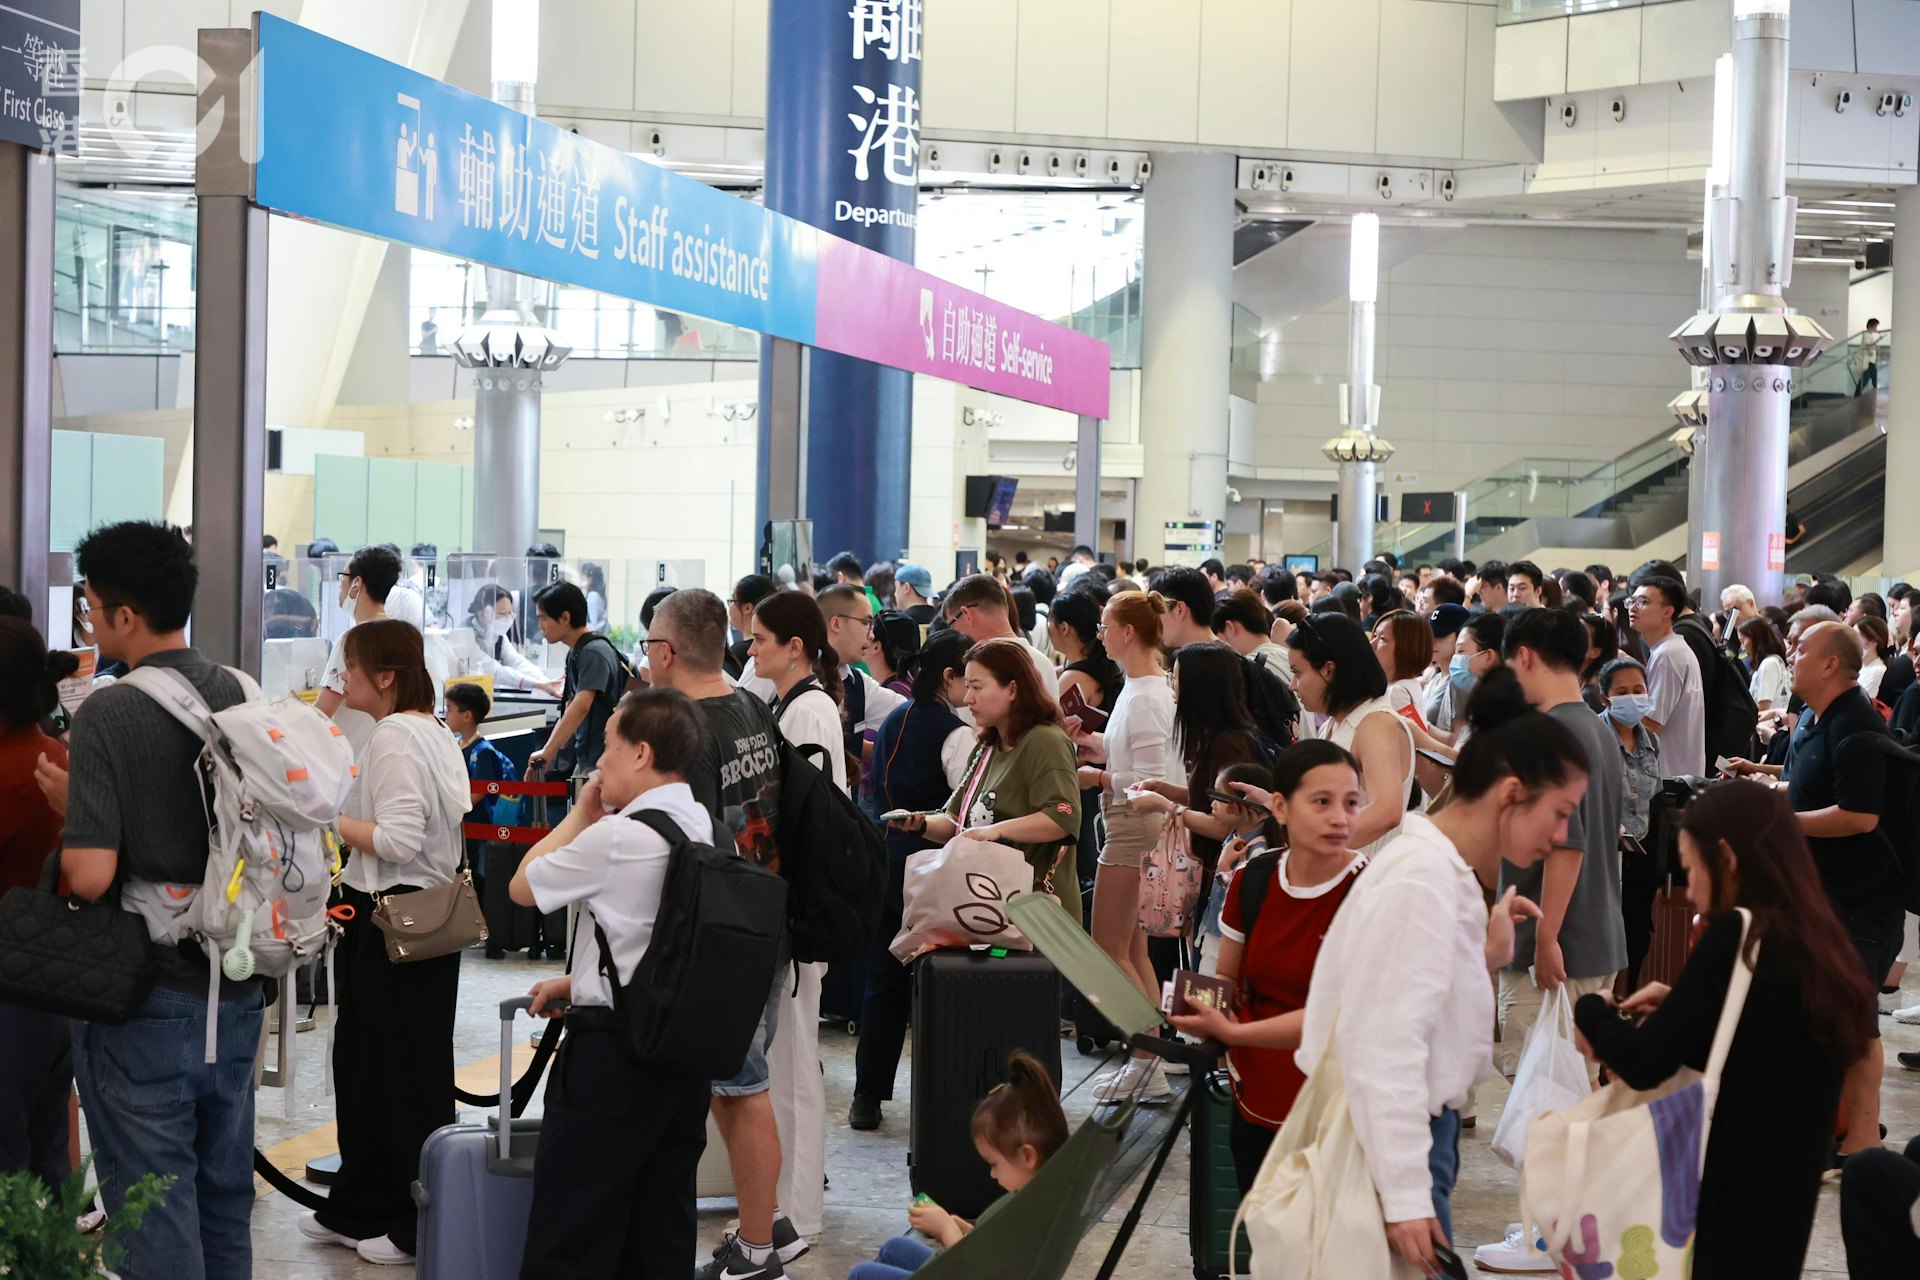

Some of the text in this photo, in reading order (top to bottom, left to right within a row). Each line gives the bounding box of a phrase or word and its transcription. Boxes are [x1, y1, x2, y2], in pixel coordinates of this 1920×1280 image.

[1, 32, 65, 89] 一等座
[3, 88, 65, 131] First Class
[458, 122, 770, 301] 輔助通道 Staff assistance
[941, 299, 1053, 385] 自助通道 Self-service
[268, 568, 275, 586] 3
[428, 568, 434, 583] 4
[552, 567, 557, 581] 5
[1430, 610, 1440, 621] C
